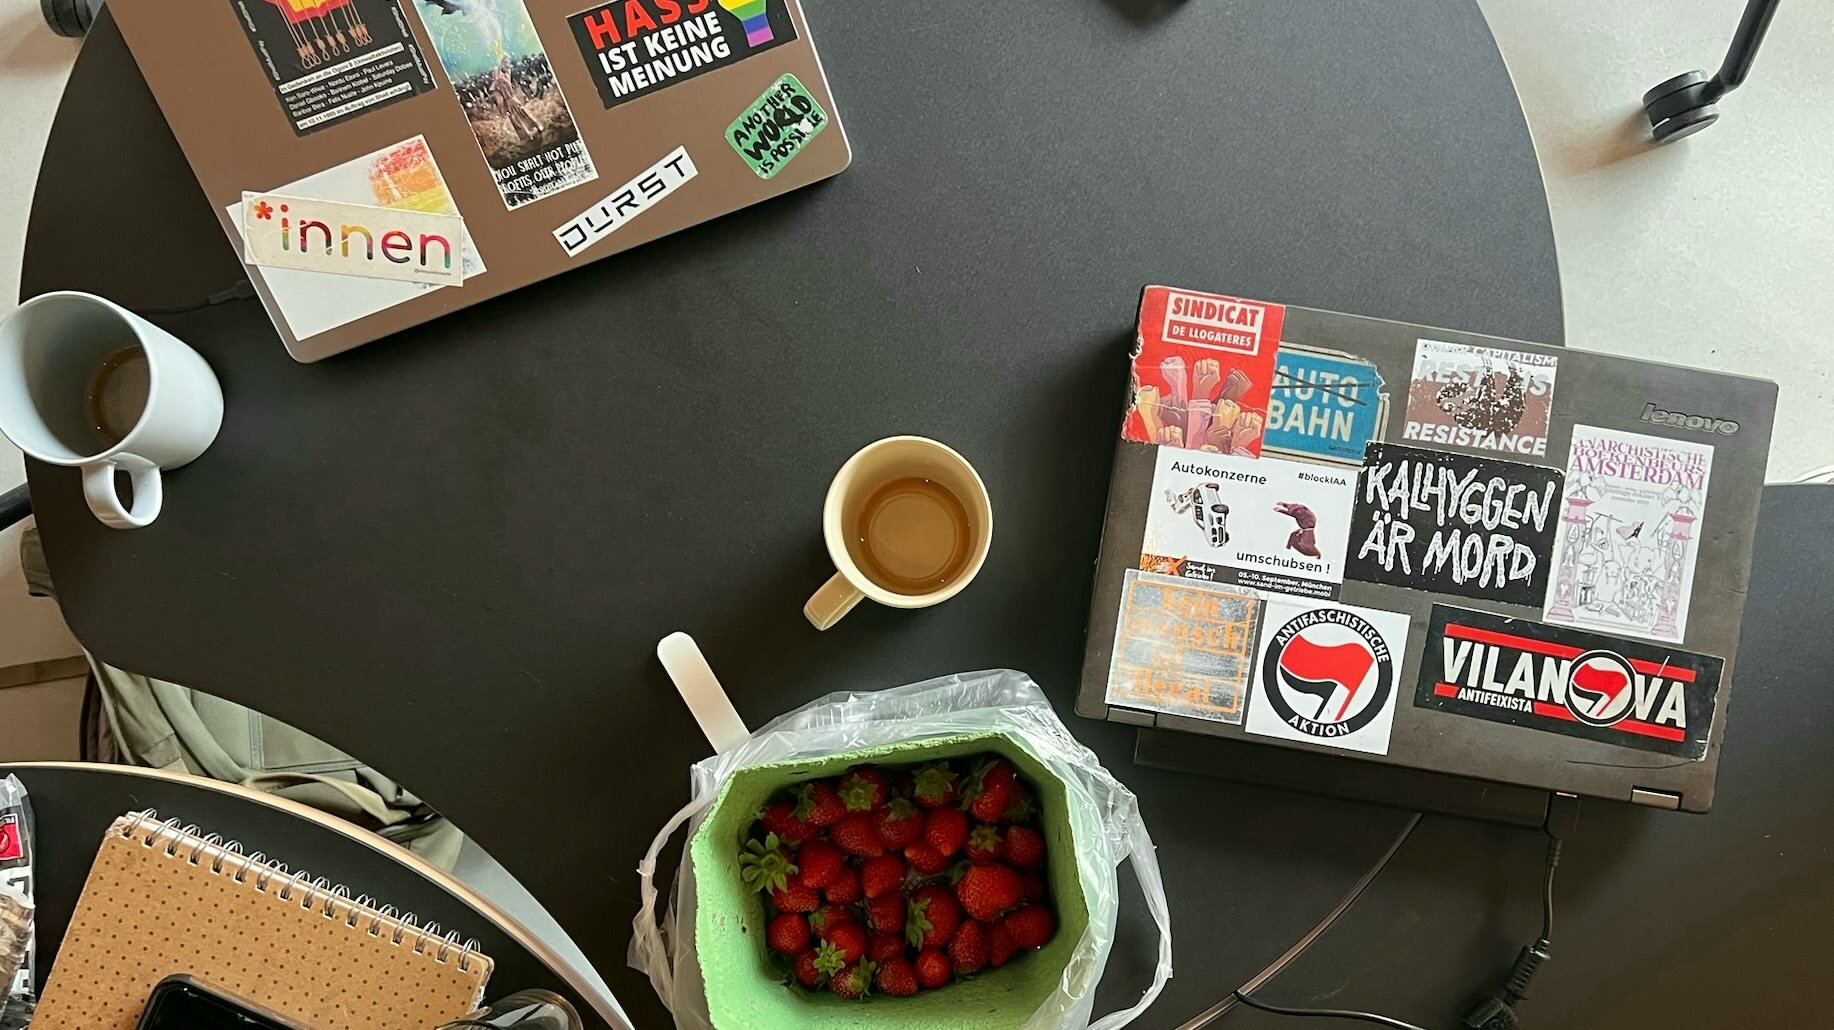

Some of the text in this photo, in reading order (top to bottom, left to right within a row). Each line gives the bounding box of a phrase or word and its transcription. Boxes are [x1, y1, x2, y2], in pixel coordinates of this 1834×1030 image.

[598, 11, 722, 75] IST KEINE
[608, 36, 731, 98] MEINUNG
[733, 83, 796, 147] ANOTHER
[744, 95, 813, 161] WORLD
[770, 110, 823, 162] POSSILE
[559, 154, 684, 251] DURST
[1172, 297, 1260, 327] SINDICAT
[1172, 325, 1252, 347] DE LLOGATERES
[1271, 365, 1359, 408] AUTO
[1266, 400, 1354, 442] BAHN
[1403, 421, 1547, 456] RESISTANCE
[1639, 402, 1741, 435] lenovo
[1171, 461, 1347, 487] Autokonzerne #blockIAA
[1569, 456, 1705, 490] AMSTERDAM
[1366, 460, 1556, 533] KALHYGGEN
[1236, 551, 1322, 573] umschubsen
[1358, 510, 1537, 589] ÄR MORD
[1301, 580, 1333, 592] München
[1276, 610, 1389, 663] ANTIFASCHISTISCHE
[1457, 687, 1533, 713] ANTIFEIXISTA
[1288, 715, 1350, 737] AKTION
